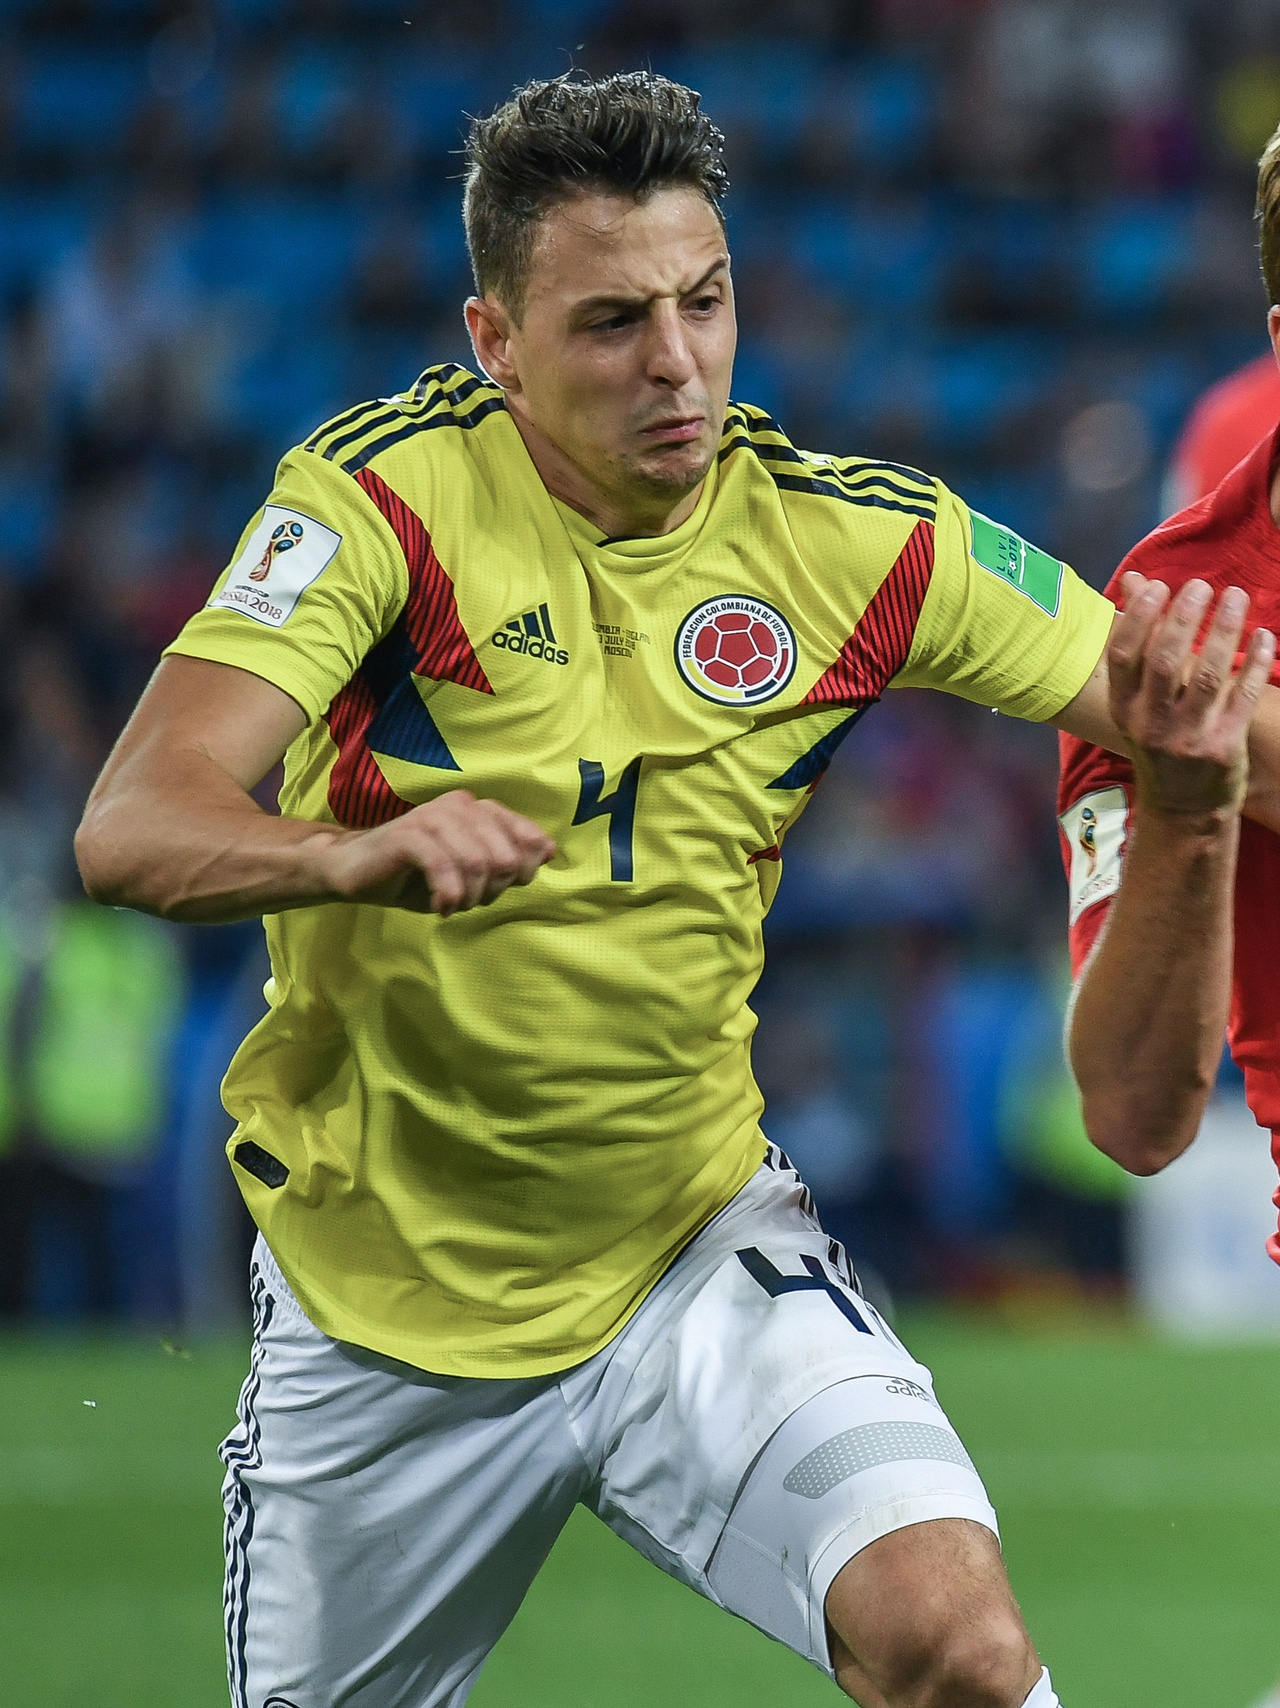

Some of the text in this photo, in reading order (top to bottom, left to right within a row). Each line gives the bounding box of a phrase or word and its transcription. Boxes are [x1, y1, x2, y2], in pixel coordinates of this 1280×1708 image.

[249, 596, 283, 619] 2018
[683, 602, 788, 658] FEDERACION COLOMBIANA DE FUTBOL
[492, 631, 569, 666] adidas
[604, 635, 624, 645] JULY
[571, 755, 644, 882] 4
[734, 1246, 875, 1337] 4
